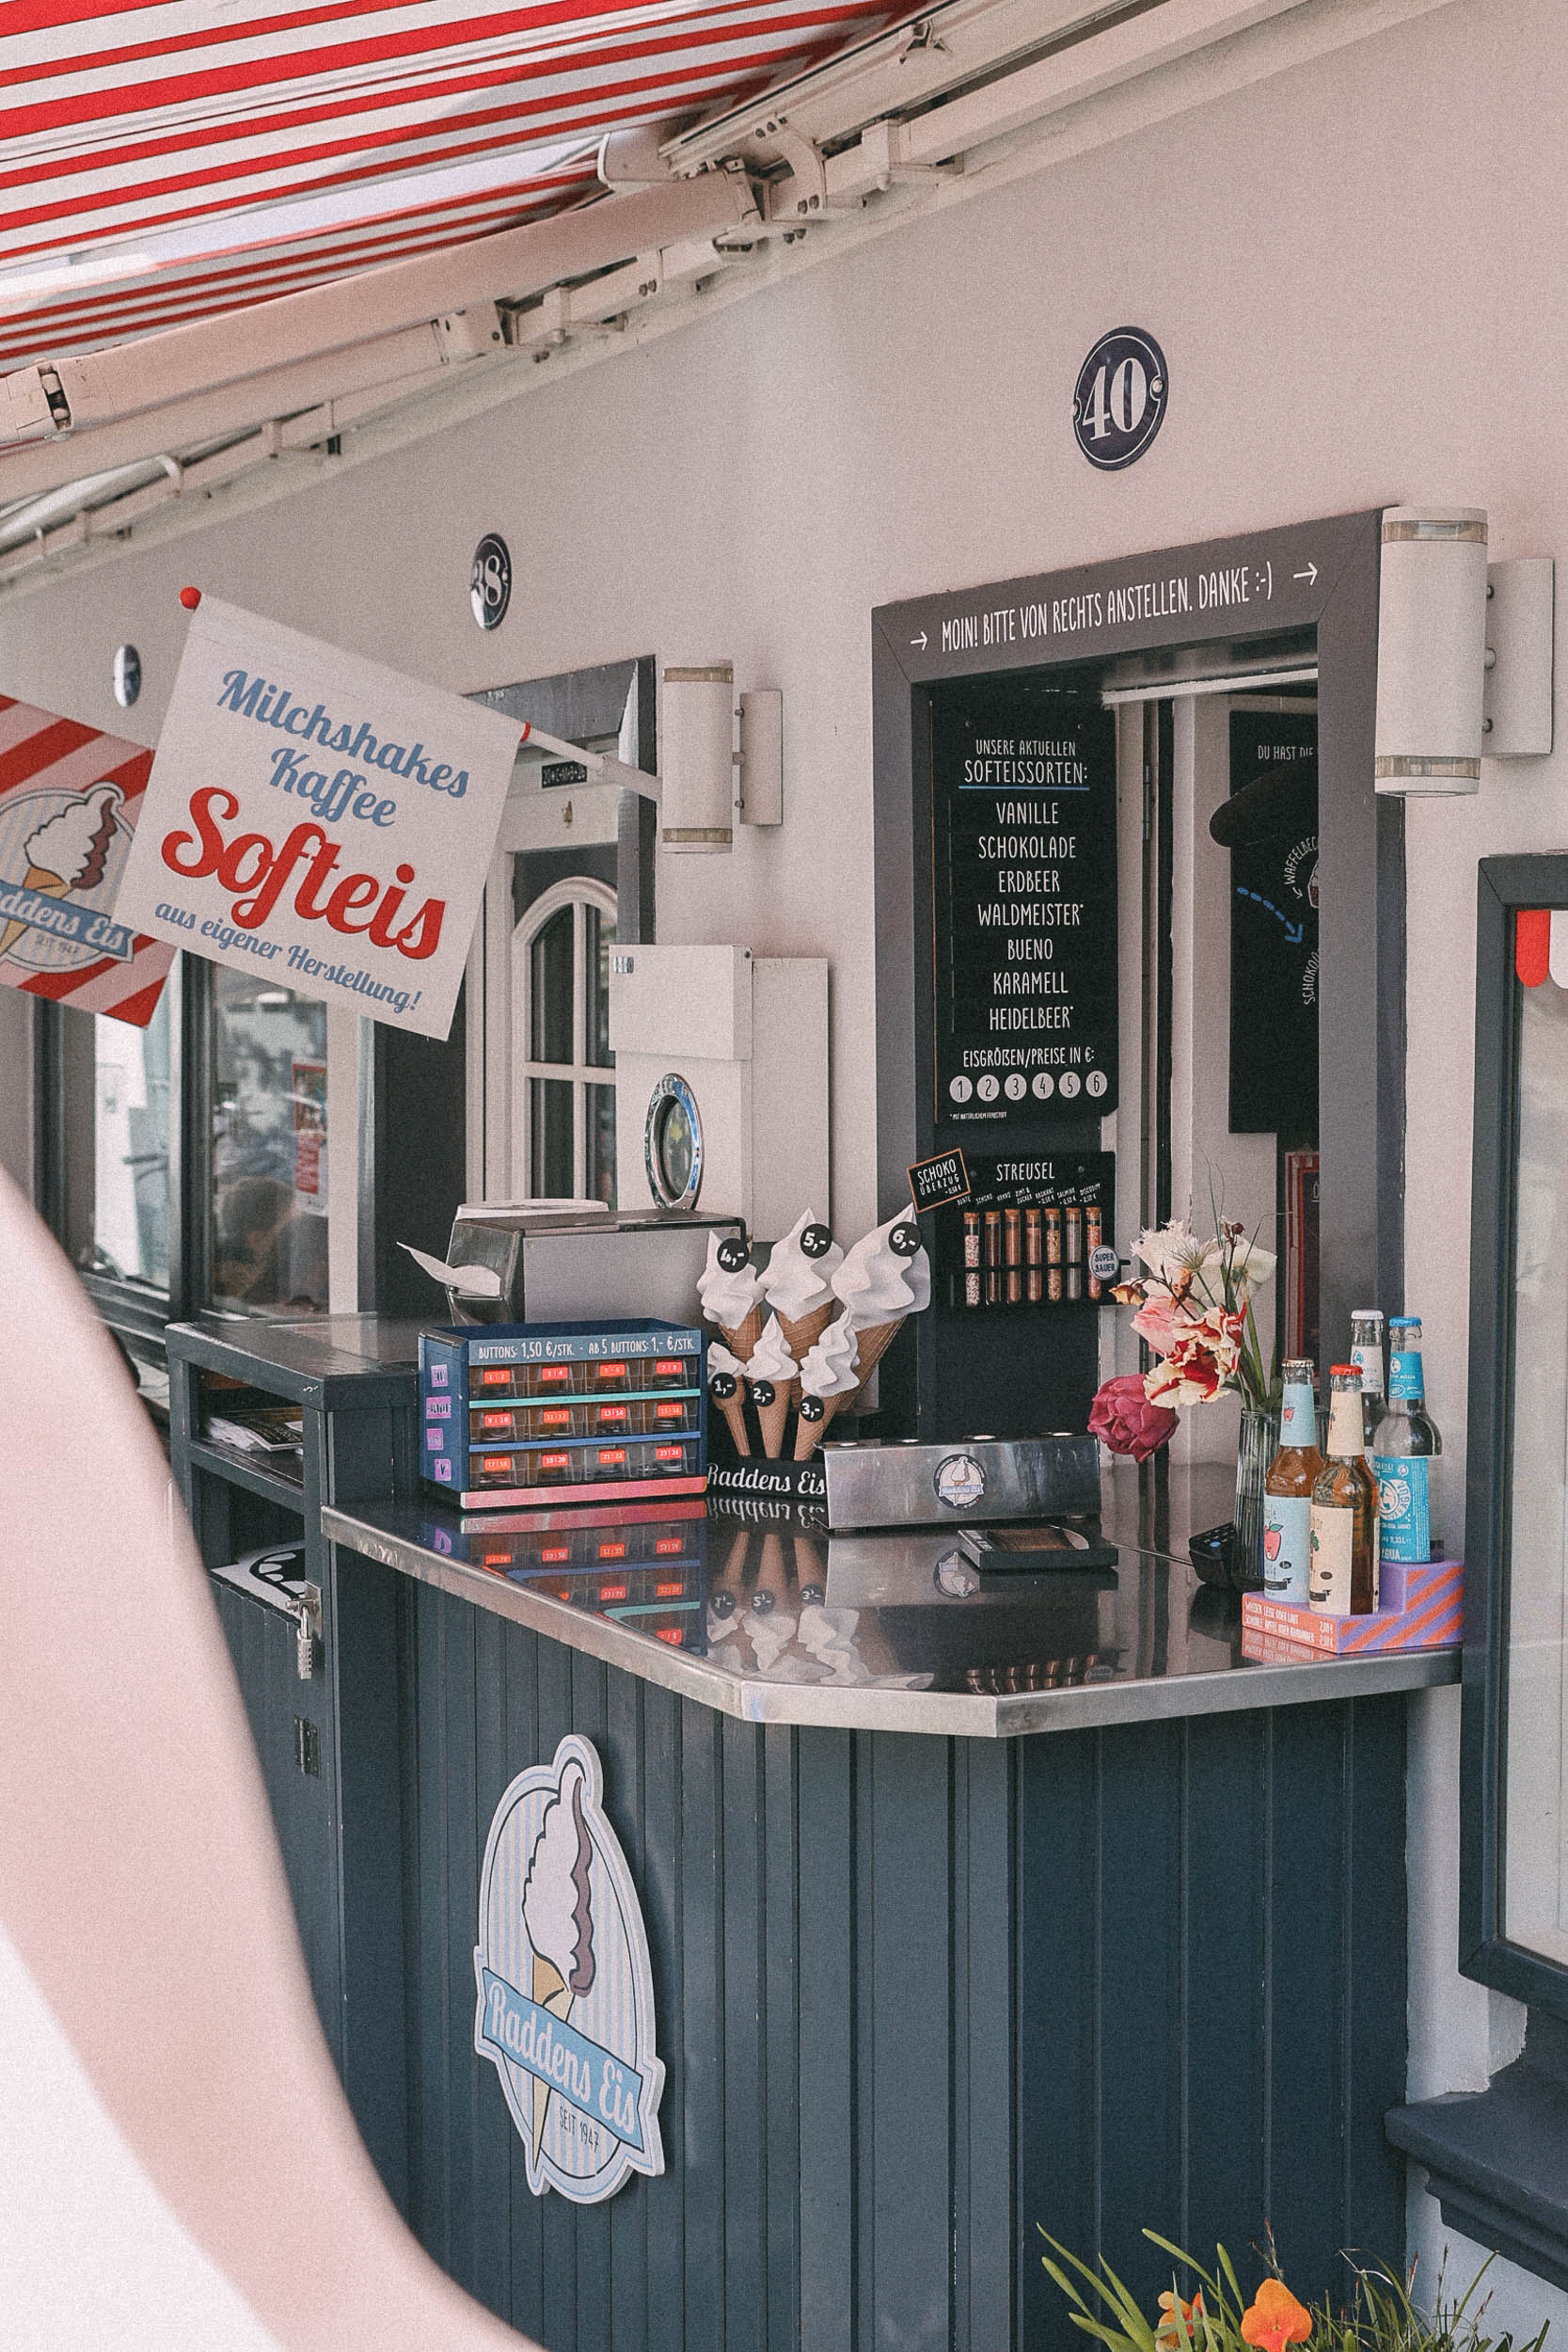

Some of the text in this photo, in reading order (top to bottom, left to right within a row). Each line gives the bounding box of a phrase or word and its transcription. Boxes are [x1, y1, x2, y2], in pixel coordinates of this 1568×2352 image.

[1083, 358, 1147, 440] 40
[942, 615, 978, 652] MOIN!
[983, 609, 1016, 644] BITTE
[1020, 604, 1047, 638] VON
[1053, 595, 1101, 633] RECHTS
[1107, 577, 1193, 626] ANSTELLEN.
[1198, 565, 1250, 610] DANKE
[216, 670, 469, 798] Milchshakes
[975, 739, 1076, 756] UNSERE AKTUELLEN
[1258, 745, 1270, 760] DU
[1273, 745, 1296, 760] HAST
[964, 760, 1087, 784] SOFTEISSORTEN:
[269, 748, 397, 827] Kaffee
[996, 803, 1059, 824] VANILLE
[978, 836, 1076, 859] SCHOKOLADE
[161, 787, 446, 960] Softeis
[999, 870, 1060, 893] ERDBEER
[0, 890, 80, 934] ddens
[86, 916, 124, 949] Eis
[154, 902, 422, 1014] aus eigener Herstellung!
[1008, 939, 1053, 961] BUENO
[993, 971, 1069, 994] KARAMELL
[1069, 1046, 1081, 1063] IN
[958, 1074, 1100, 1099] 1 2 3 4 5 6
[917, 1158, 957, 1185] SCHOKO
[996, 1162, 1055, 1182] STREUSEL
[803, 1232, 827, 1251] 5,-
[893, 1229, 916, 1249] 6,-
[1094, 1252, 1115, 1263] SUPER
[479, 1345, 517, 1359] BUTTONS:
[520, 1341, 542, 1358] 1,50
[589, 1343, 600, 1355] AB
[602, 1339, 608, 1355] 5
[610, 1340, 649, 1354] BUTTONS:
[714, 1379, 733, 1394] 1,-
[753, 1388, 771, 1403] 2,-
[801, 1403, 820, 1418] 3,-
[707, 1463, 826, 1495] Raddens Eis
[489, 1981, 635, 2135] Raddens Eis
[560, 2106, 599, 2153] SEIT 1947
